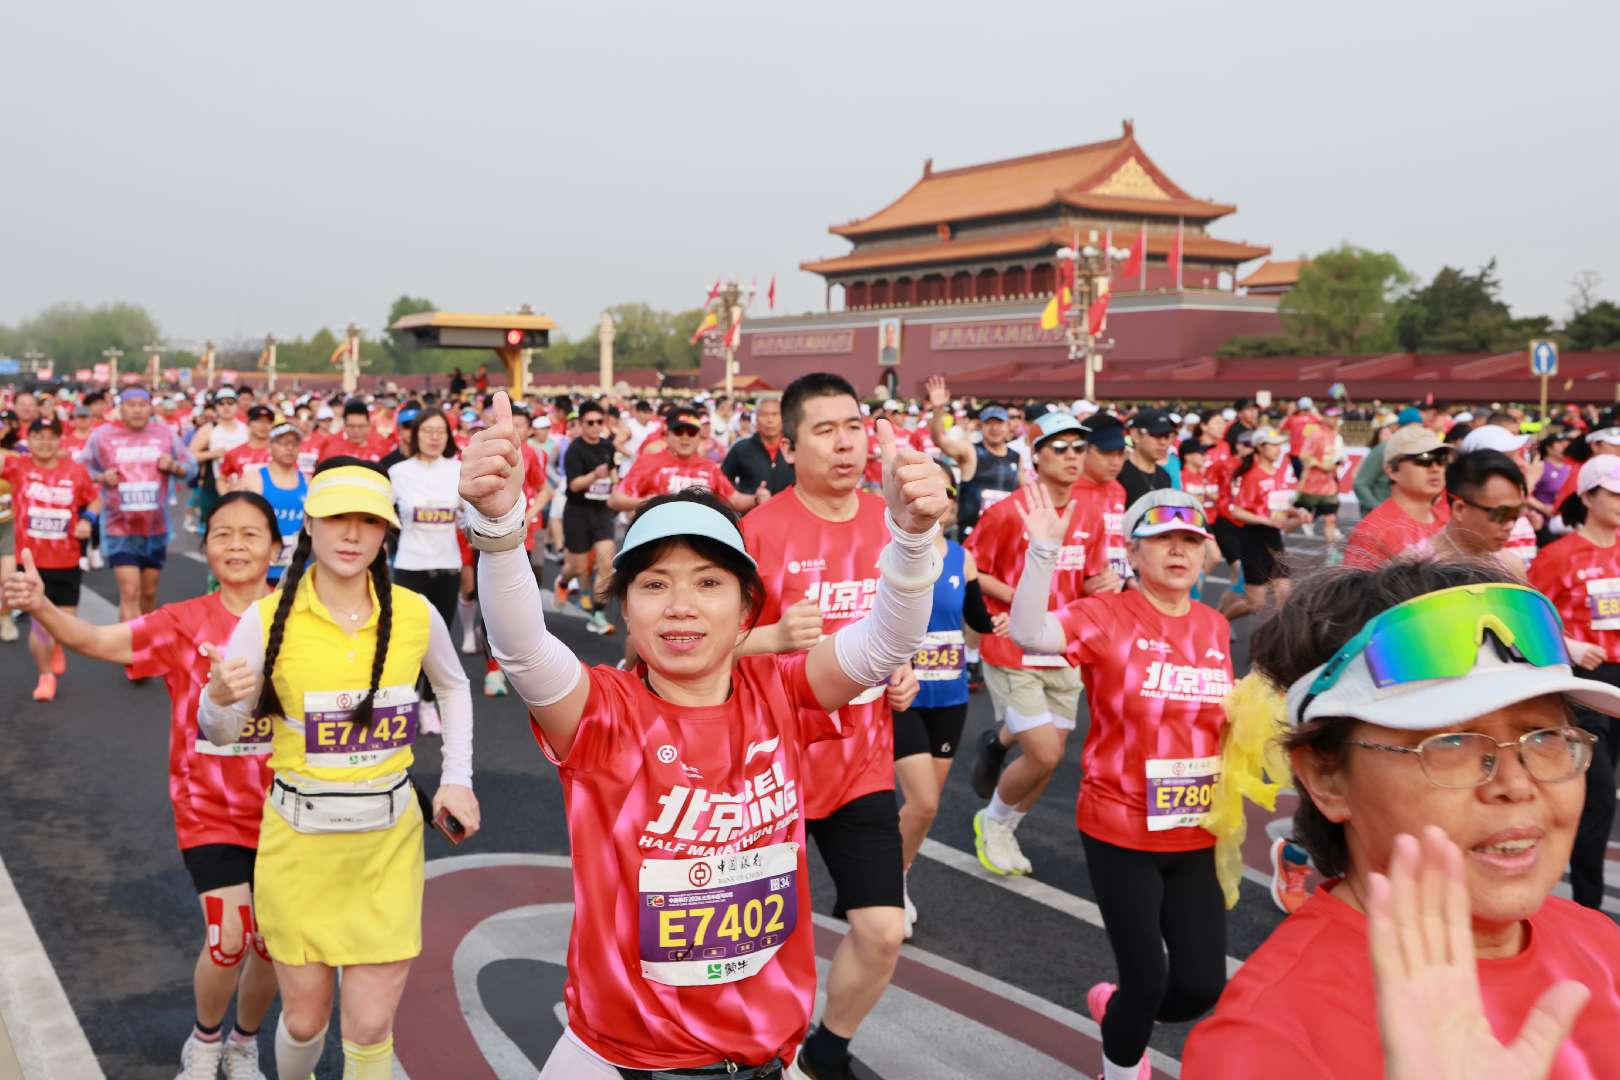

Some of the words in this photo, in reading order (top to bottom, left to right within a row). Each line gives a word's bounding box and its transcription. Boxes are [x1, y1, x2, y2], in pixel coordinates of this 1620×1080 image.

[804, 580, 862, 611] 北京
[1142, 661, 1200, 693] 北京
[745, 761, 785, 802] BEI
[645, 785, 745, 843] 北京
[741, 780, 798, 833] JING
[638, 835, 685, 852] HALF
[687, 825, 774, 856] MARATHON
[717, 853, 762, 875] 中国银行
[659, 894, 785, 947] E7402
[725, 960, 748, 975] 蒙牛
